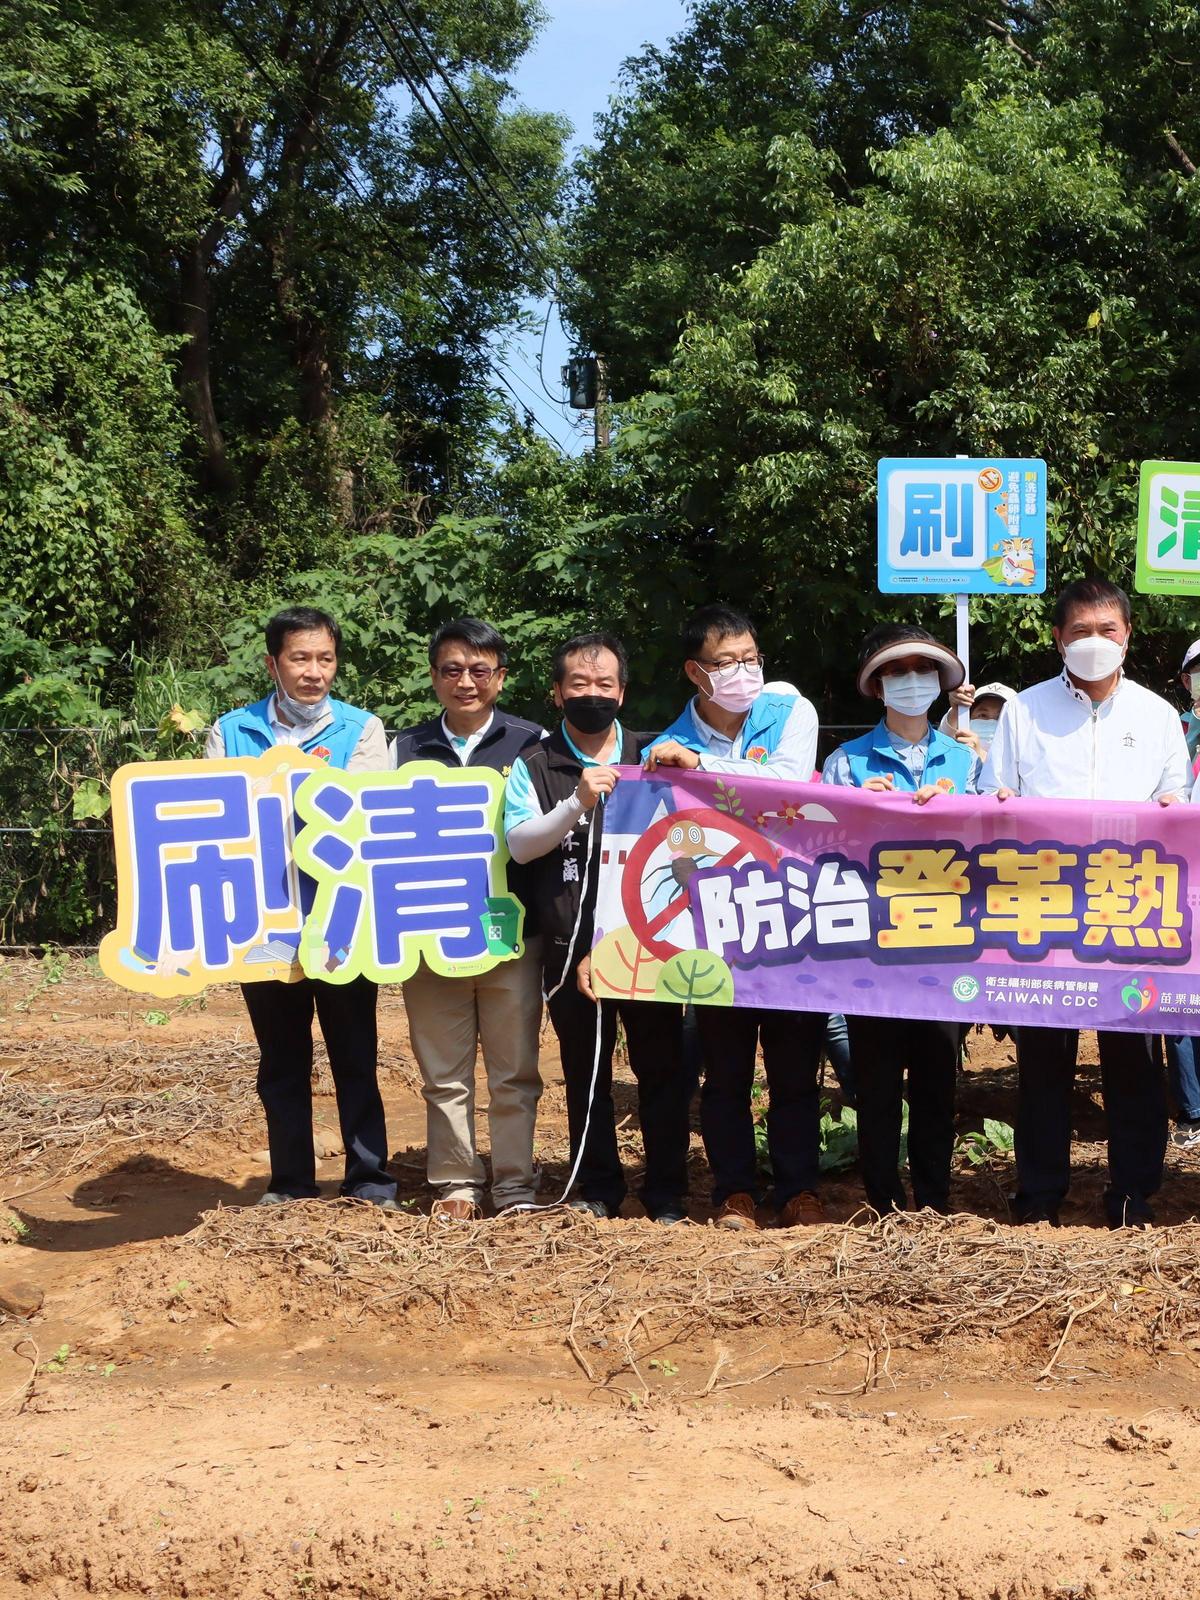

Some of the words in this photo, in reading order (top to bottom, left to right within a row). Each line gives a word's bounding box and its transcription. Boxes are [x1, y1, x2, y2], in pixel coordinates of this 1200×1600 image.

[900, 483, 974, 558] 刷
[1024, 471, 1038, 515] 刷洗容器
[132, 773, 318, 966] 刷
[312, 778, 495, 966] 清
[697, 847, 1184, 958] 防治登革熱
[985, 976, 1099, 992] 衛生福利部疾病管制署
[985, 991, 1054, 1005] TAIWAN
[1061, 994, 1098, 1008] CDC
